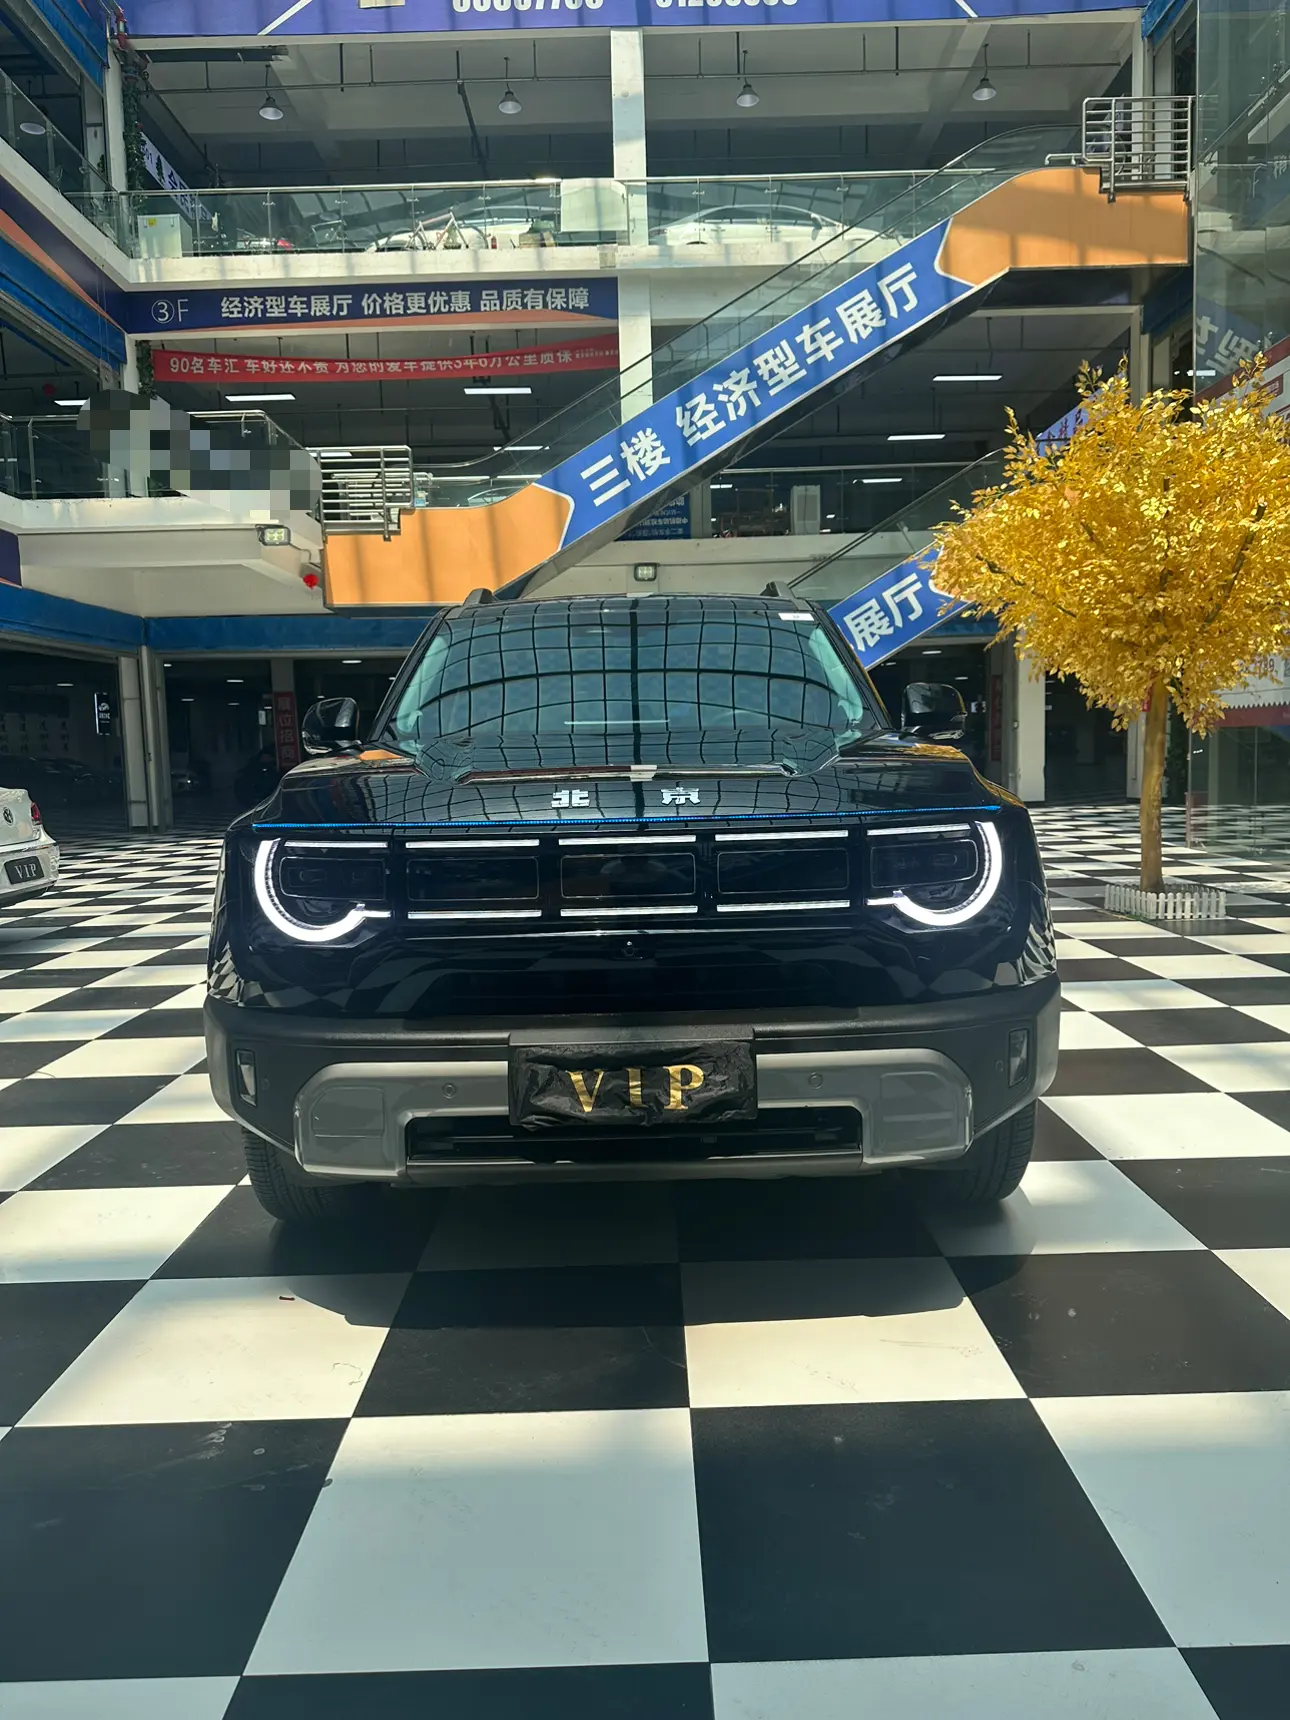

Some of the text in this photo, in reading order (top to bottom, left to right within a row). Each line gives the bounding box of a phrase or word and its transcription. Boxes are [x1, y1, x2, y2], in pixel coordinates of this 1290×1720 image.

[221, 294, 352, 318] 经济型车展厅
[361, 290, 471, 315] 价格更优惠
[480, 287, 590, 312] 品质有保障
[169, 356, 240, 374] 90名车汇
[580, 262, 920, 507] 三楼 经济型车展厅
[843, 573, 923, 652] 展厅
[551, 787, 701, 808] 北京
[15, 863, 37, 879] VIP
[566, 1064, 704, 1113] VIP
